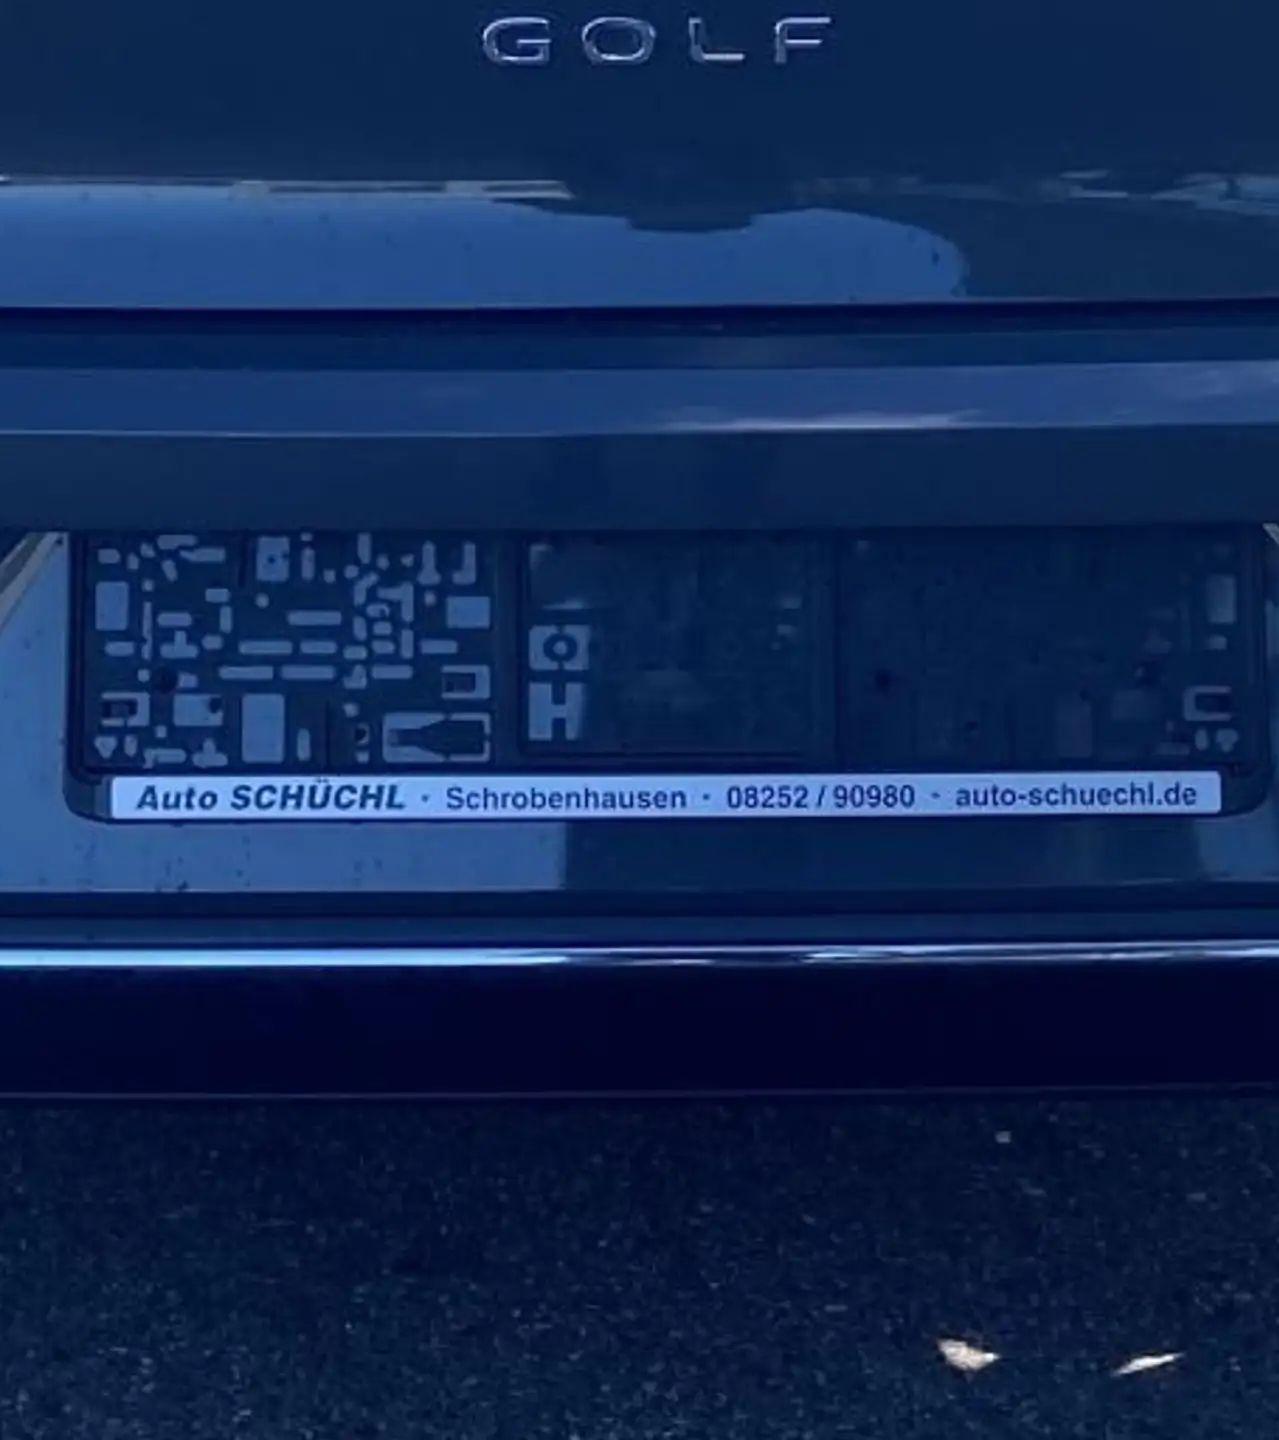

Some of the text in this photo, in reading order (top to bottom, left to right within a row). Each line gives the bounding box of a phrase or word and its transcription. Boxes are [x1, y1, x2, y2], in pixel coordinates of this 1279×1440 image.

[482, 15, 832, 64] GOLF
[136, 784, 218, 811] Auto
[229, 777, 406, 811] SCHÜCHL
[445, 786, 688, 810] Schrobenhausen
[726, 784, 809, 809] 08252
[832, 784, 916, 809] 90980
[955, 781, 1198, 807] auto-schuechl.de
